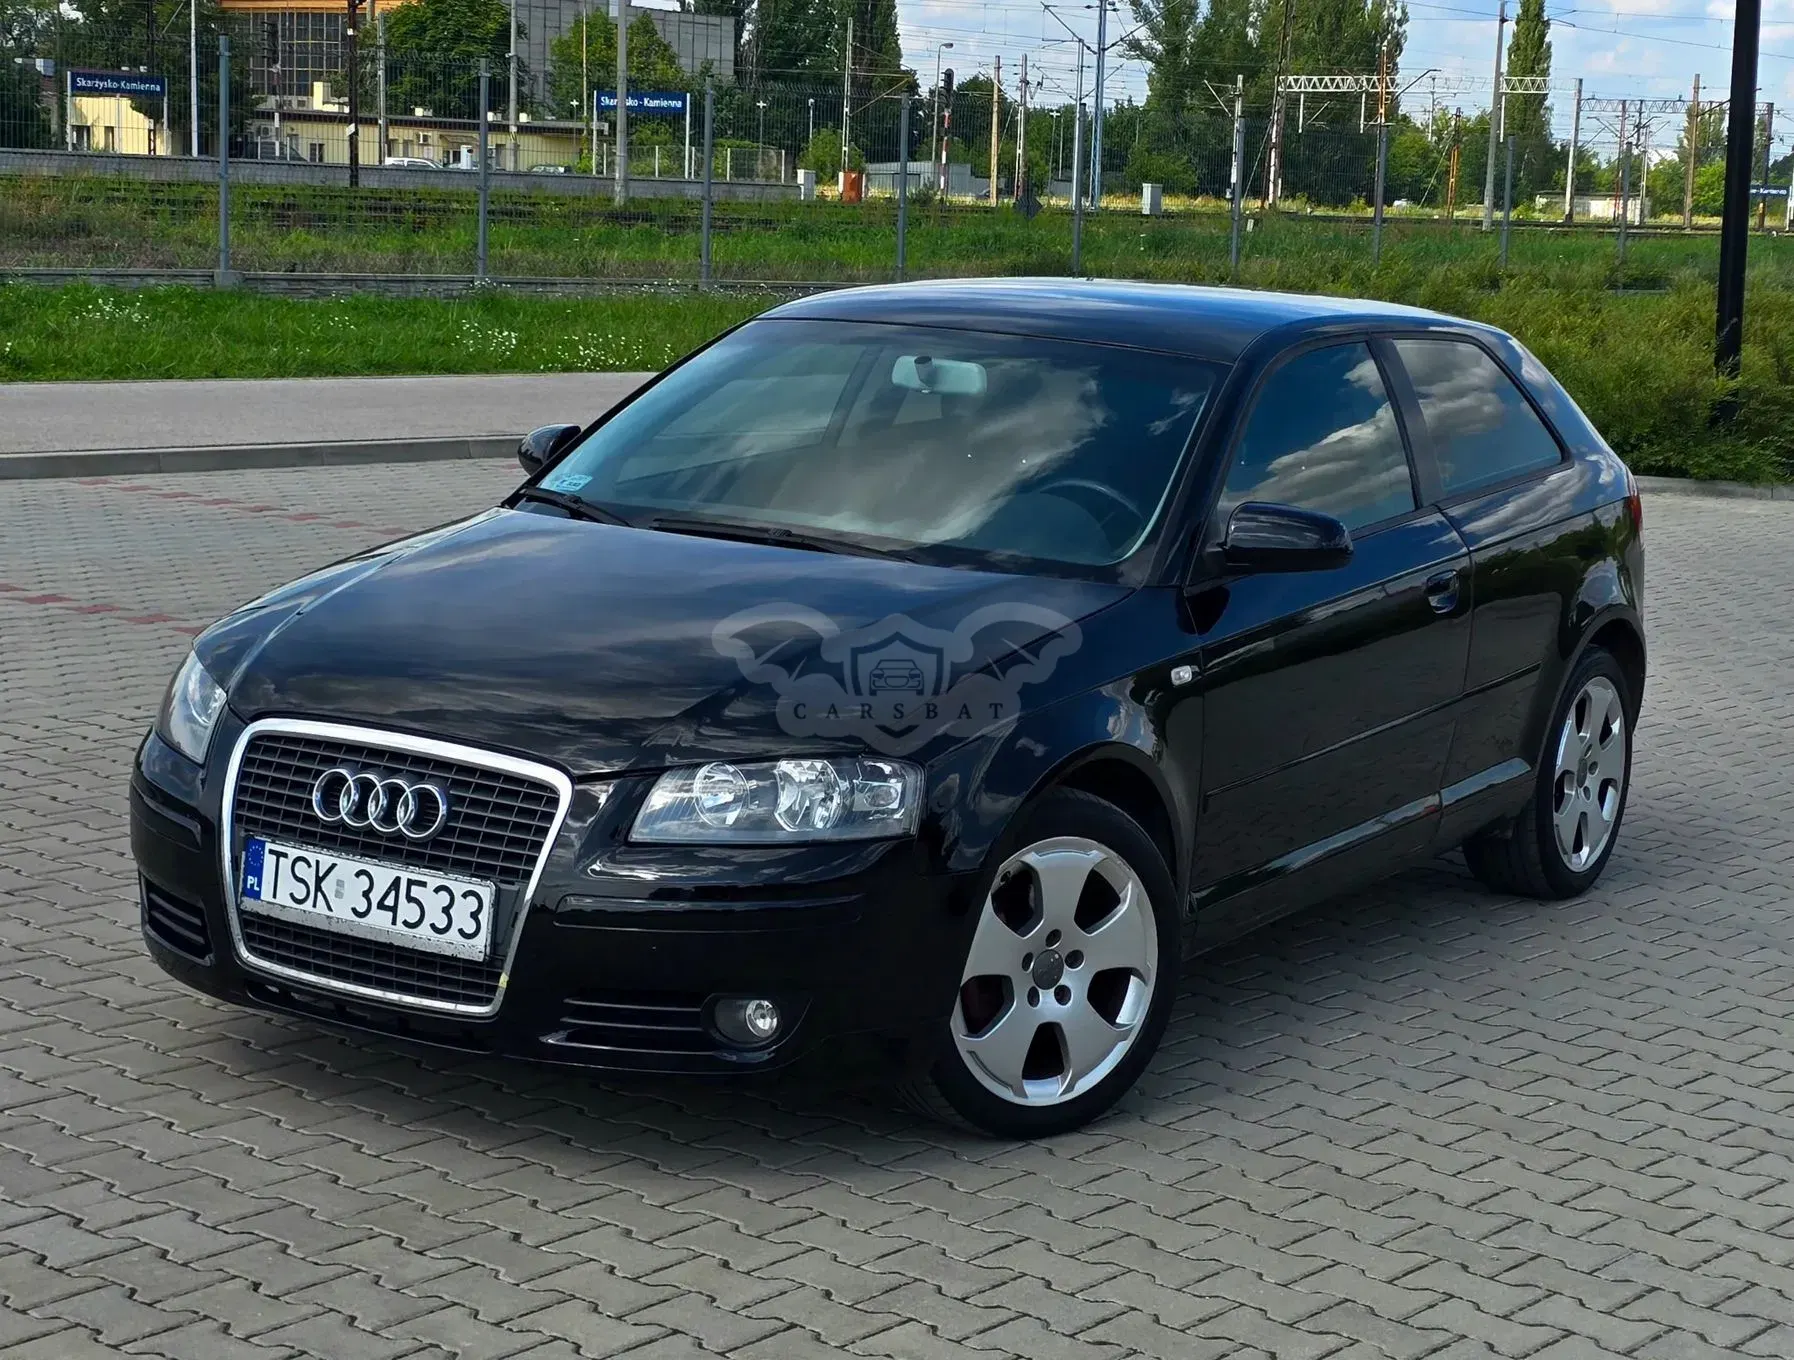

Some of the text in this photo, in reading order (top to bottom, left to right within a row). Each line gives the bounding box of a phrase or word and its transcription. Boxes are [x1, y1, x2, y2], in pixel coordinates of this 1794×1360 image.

[600, 96, 638, 107] Skarsko
[247, 875, 260, 891] PL
[268, 848, 484, 940] TSK 34533
